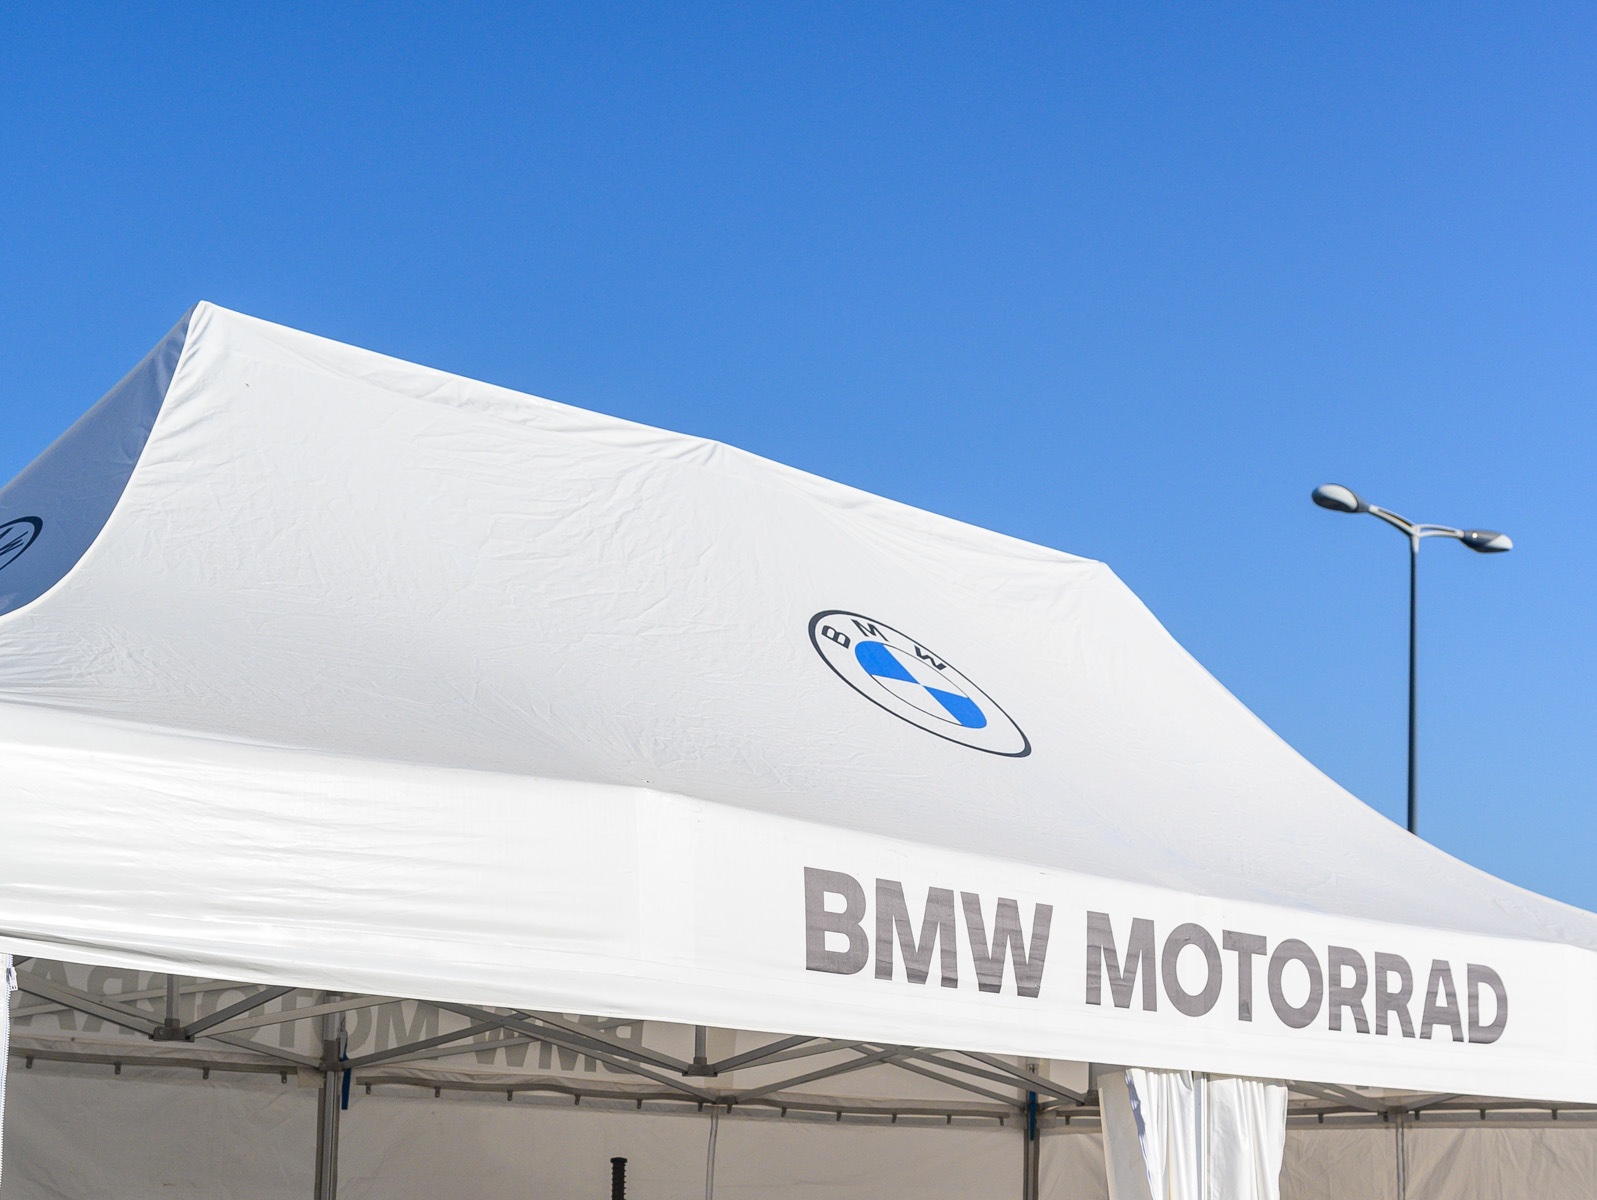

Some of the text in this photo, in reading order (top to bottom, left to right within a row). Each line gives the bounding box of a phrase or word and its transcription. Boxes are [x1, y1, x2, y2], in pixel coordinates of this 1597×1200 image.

[821, 618, 948, 672] BMW
[804, 866, 1509, 1045] BMW MOTORRAD
